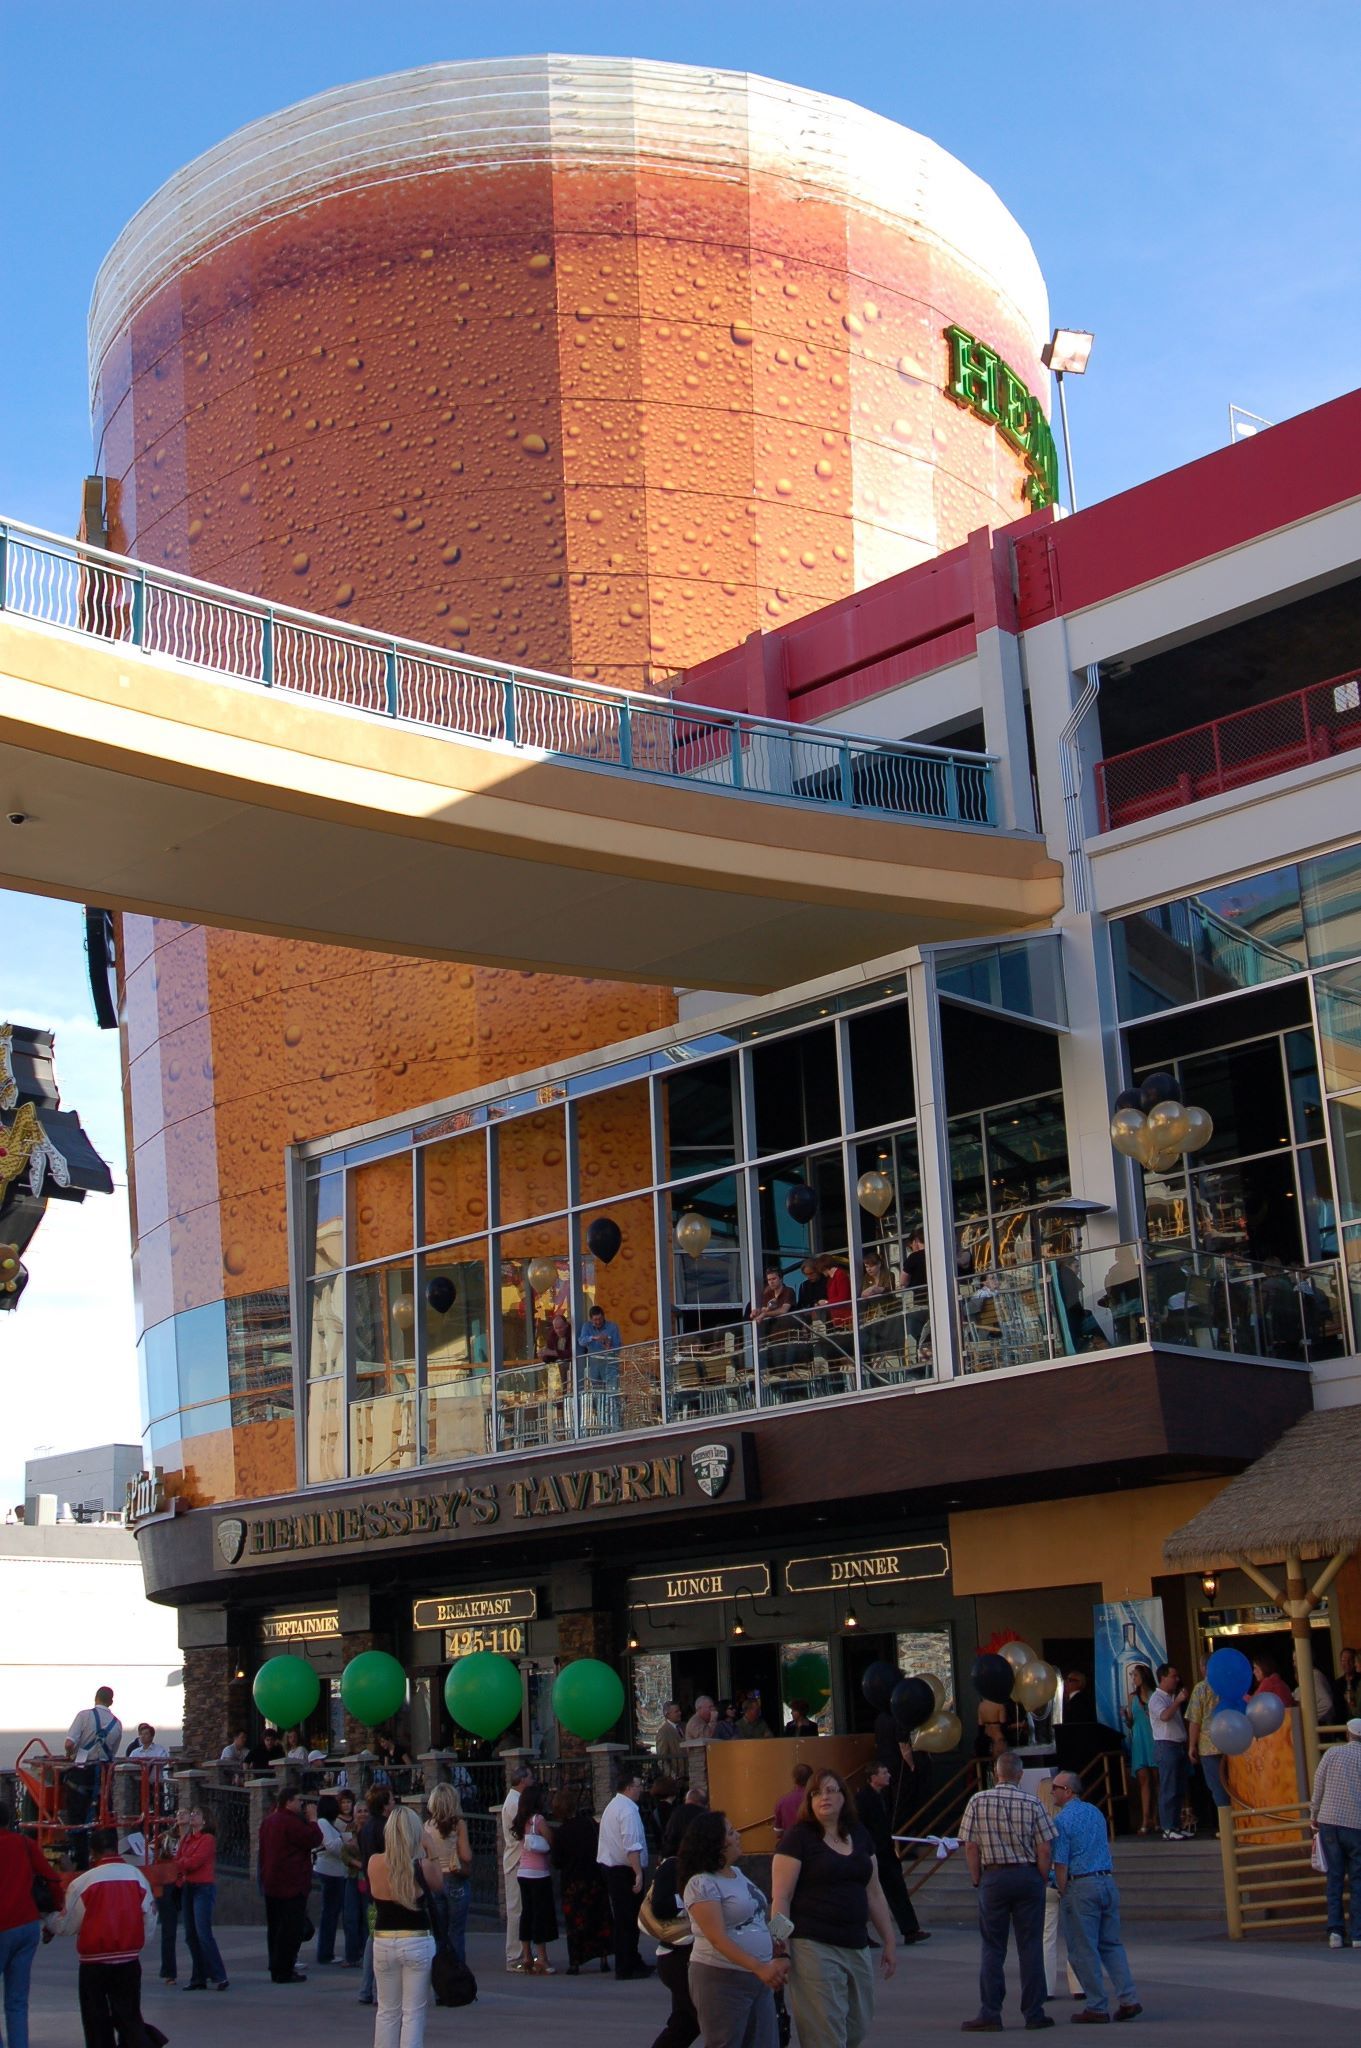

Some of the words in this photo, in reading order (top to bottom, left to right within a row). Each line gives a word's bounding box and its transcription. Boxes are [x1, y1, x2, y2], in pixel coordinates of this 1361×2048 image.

[249, 1484, 498, 1555] HENNESSEY'S
[507, 1455, 684, 1519] TAVERN
[831, 1556, 900, 1580] DINNER
[667, 1575, 723, 1597] LUNCH
[437, 1599, 511, 1621] BREAKFAST
[262, 1616, 339, 1637] NTERTAINMEN
[449, 1627, 521, 1657] 425-110
